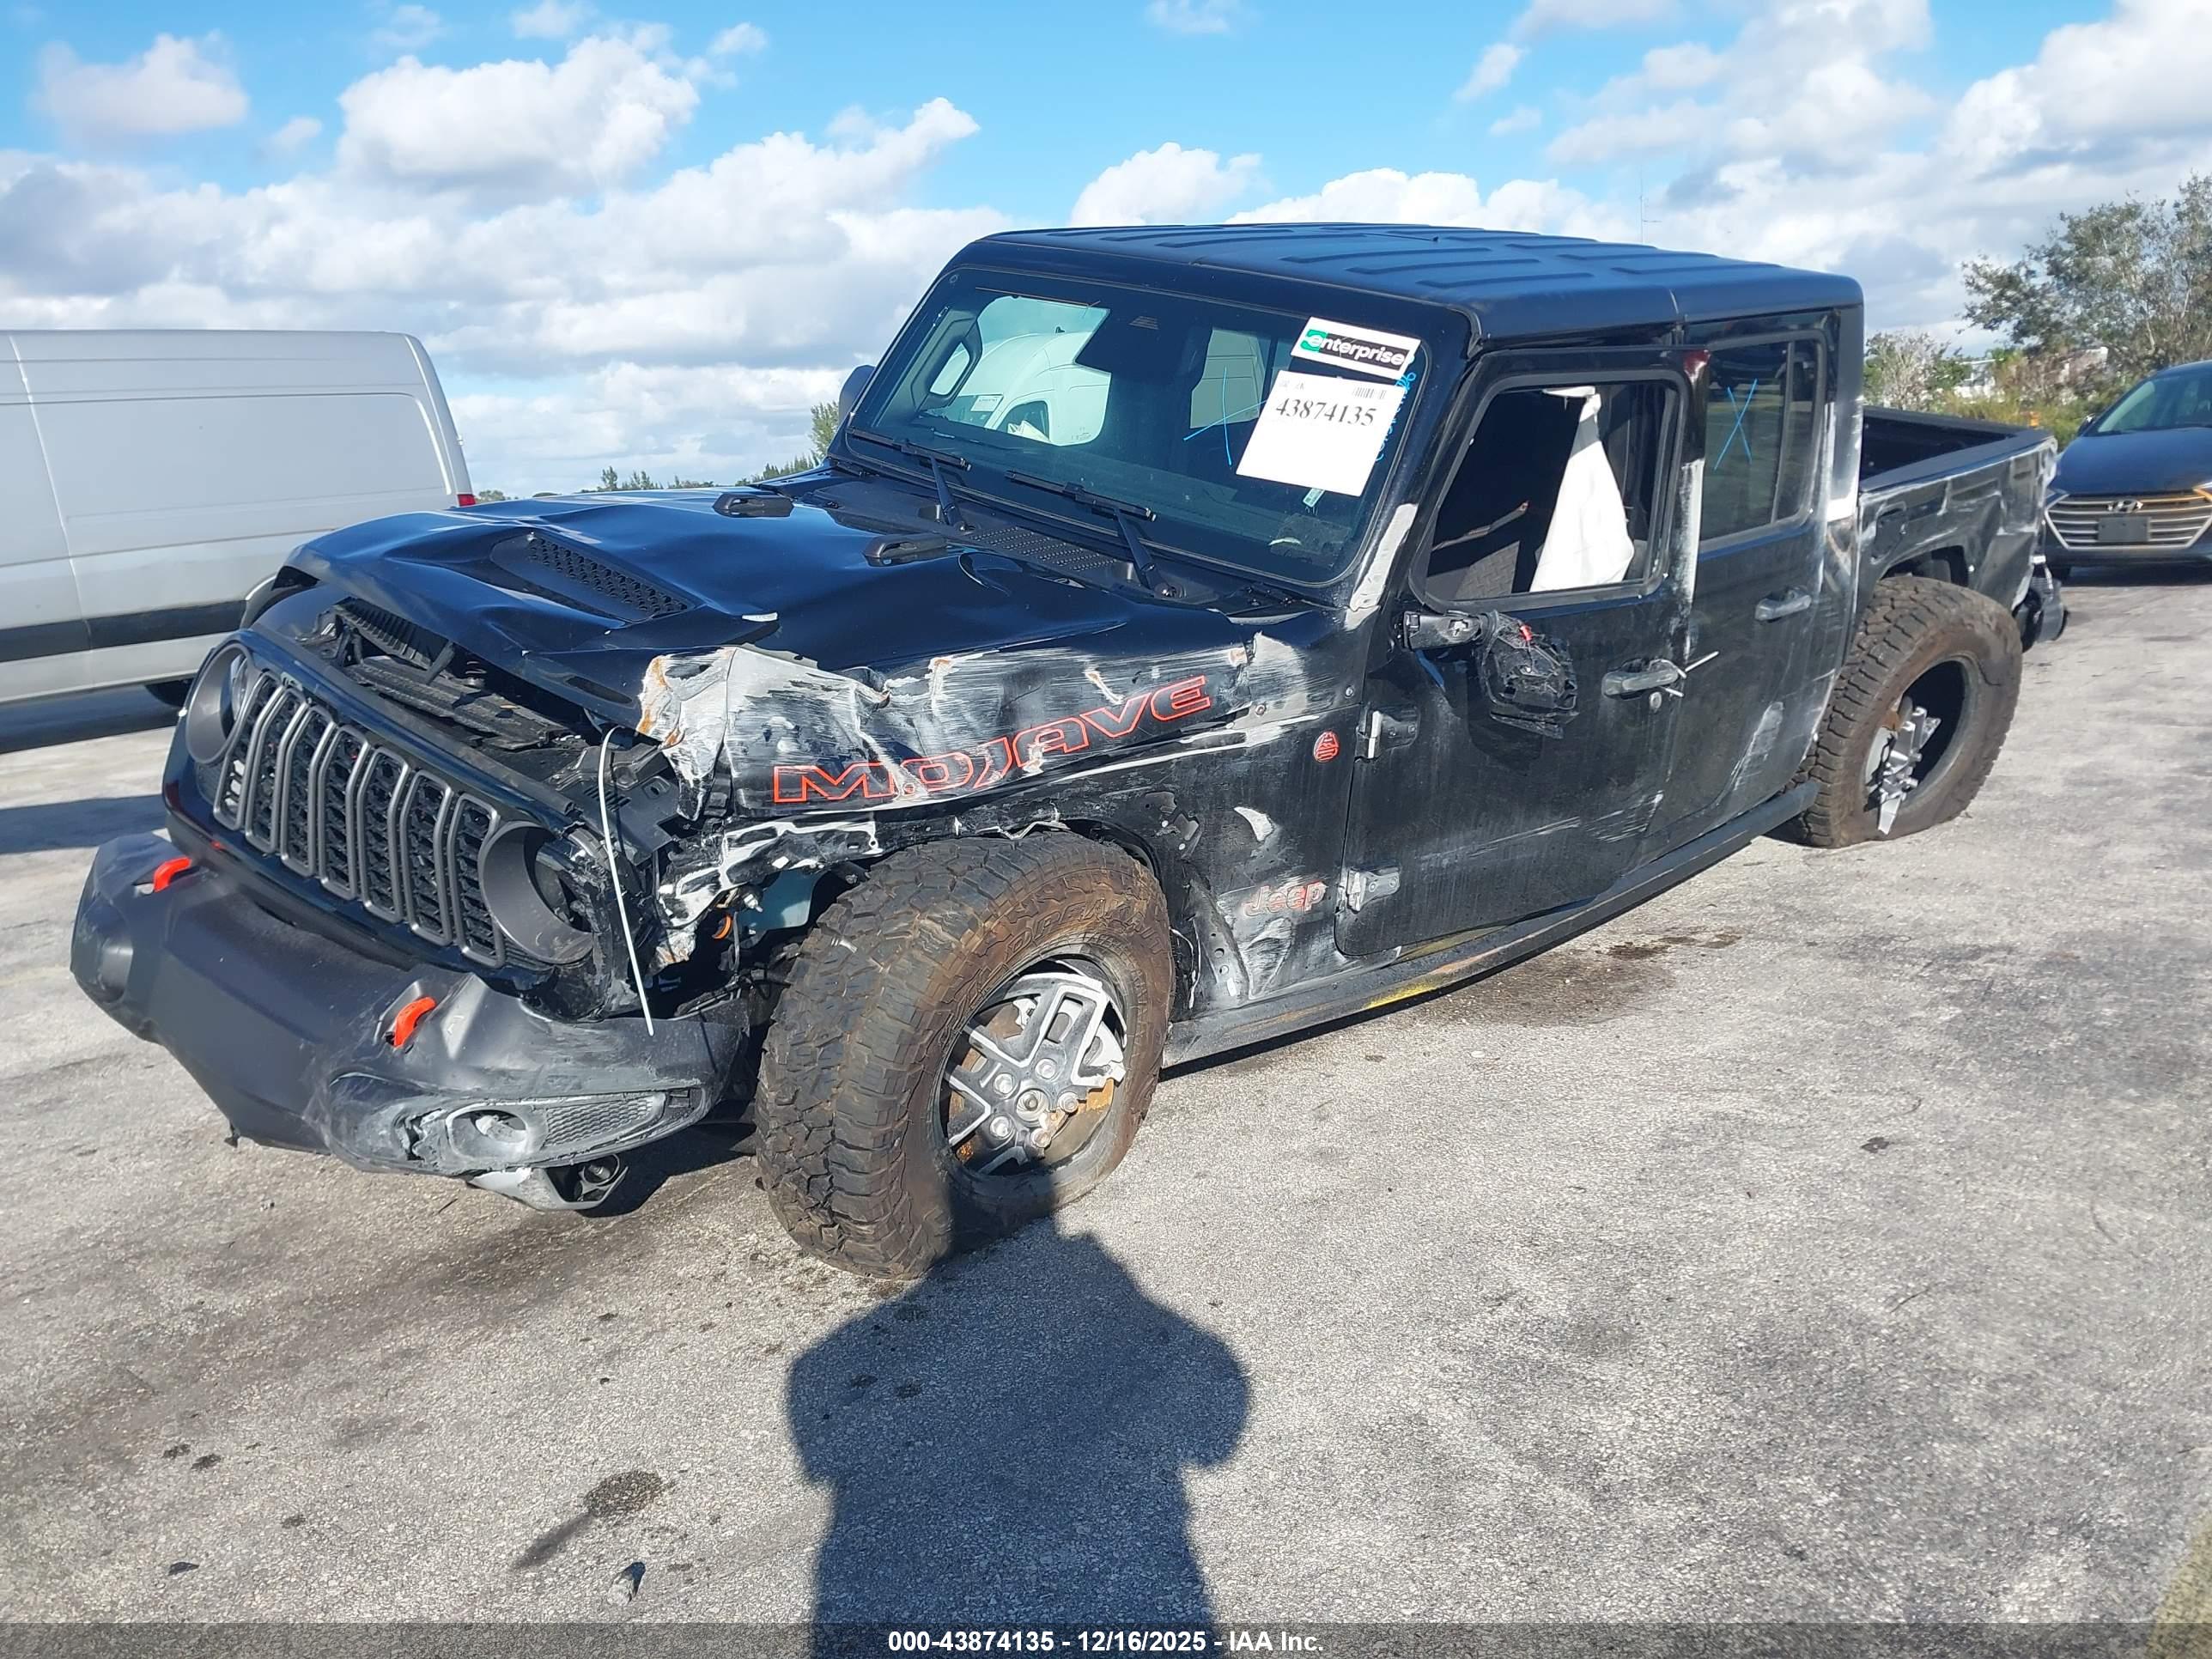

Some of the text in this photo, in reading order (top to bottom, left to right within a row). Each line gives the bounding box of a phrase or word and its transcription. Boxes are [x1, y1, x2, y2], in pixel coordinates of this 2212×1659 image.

[1310, 333, 1406, 367] enterprise
[1276, 398, 1377, 426] 43874135
[773, 675, 1212, 803] MOJAVE
[1243, 879, 1329, 917] Jeep
